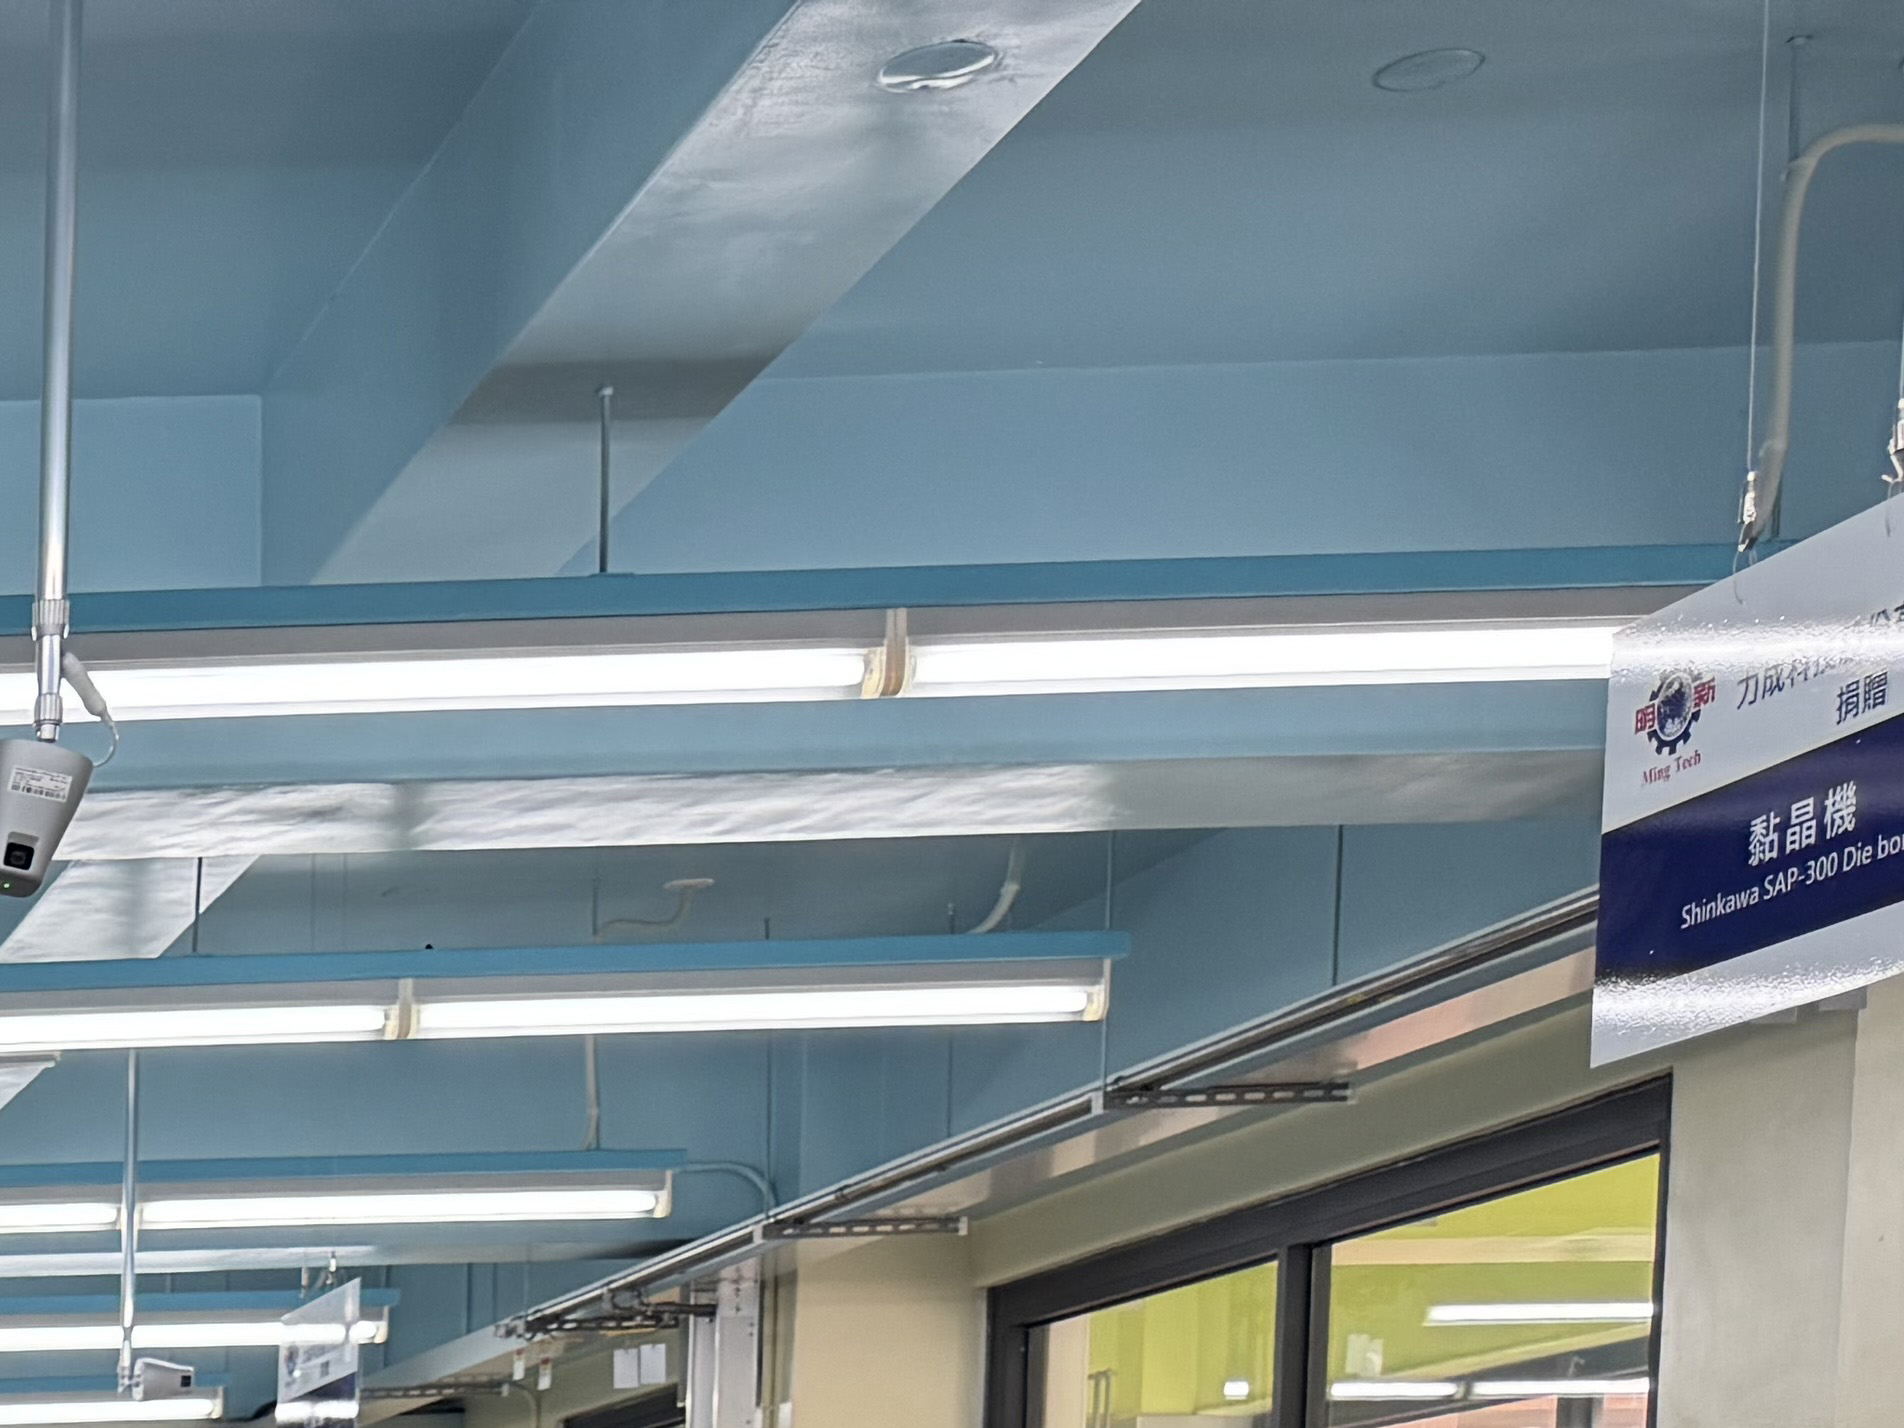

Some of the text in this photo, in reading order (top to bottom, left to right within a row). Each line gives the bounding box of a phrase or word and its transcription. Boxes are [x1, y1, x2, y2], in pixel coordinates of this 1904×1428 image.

[1635, 676, 1716, 735] 明 新
[1836, 668, 1889, 726] 捐贈
[1674, 749, 1702, 773] Tech
[1747, 780, 1857, 868] 黏晶機
[1680, 886, 1760, 930] Shinkawa
[1763, 851, 1839, 900] SAP-300
[1842, 842, 1874, 873] Die
